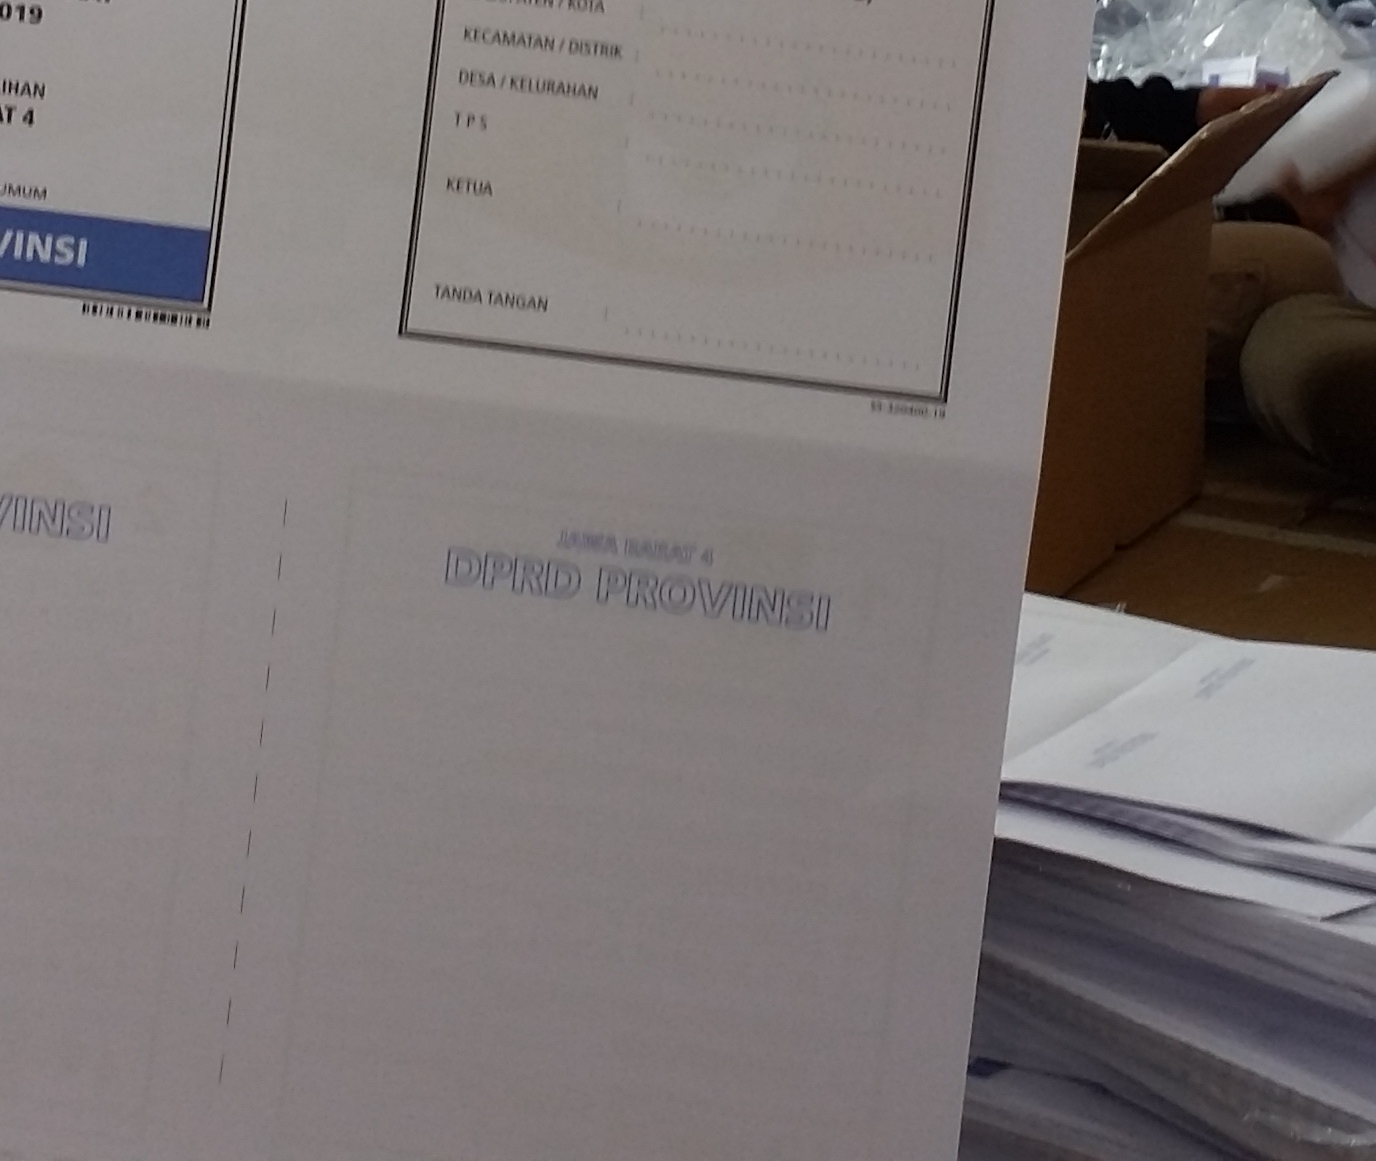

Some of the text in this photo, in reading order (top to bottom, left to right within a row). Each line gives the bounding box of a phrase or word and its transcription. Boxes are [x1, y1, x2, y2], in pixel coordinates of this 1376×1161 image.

[458, 68, 496, 89] DESA
[21, 106, 36, 128] 4
[446, 177, 493, 197] KETUA
[434, 283, 483, 305] TANDA
[443, 546, 832, 633] DPRD PROVINSI
